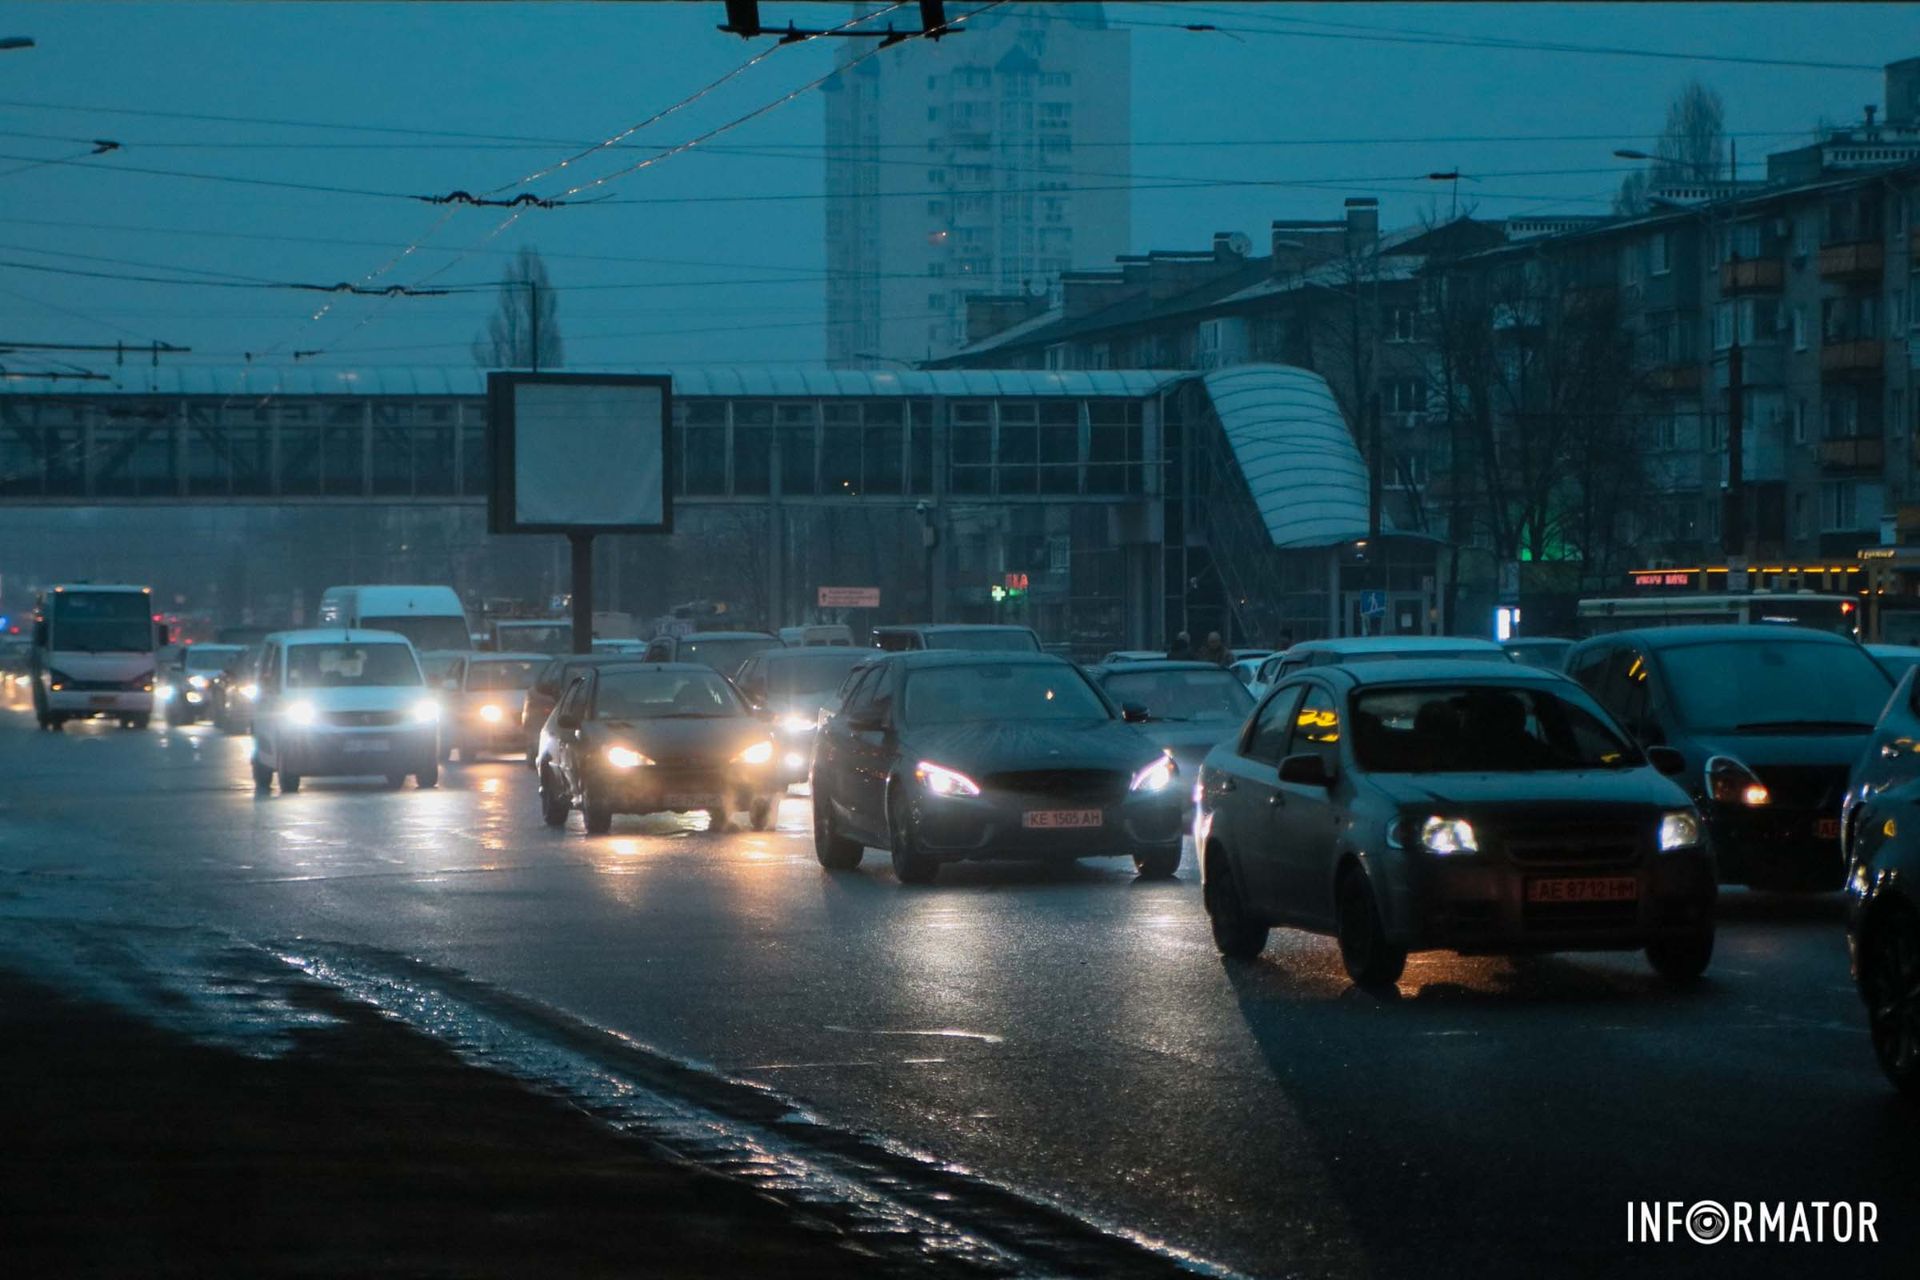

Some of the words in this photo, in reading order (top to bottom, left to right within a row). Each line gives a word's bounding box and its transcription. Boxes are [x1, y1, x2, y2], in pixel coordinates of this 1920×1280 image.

[1030, 812, 1048, 826] KE
[1054, 812, 1079, 825] 1505
[1082, 811, 1100, 825] AH
[1539, 881, 1563, 899] AE
[1567, 880, 1607, 898] 8712
